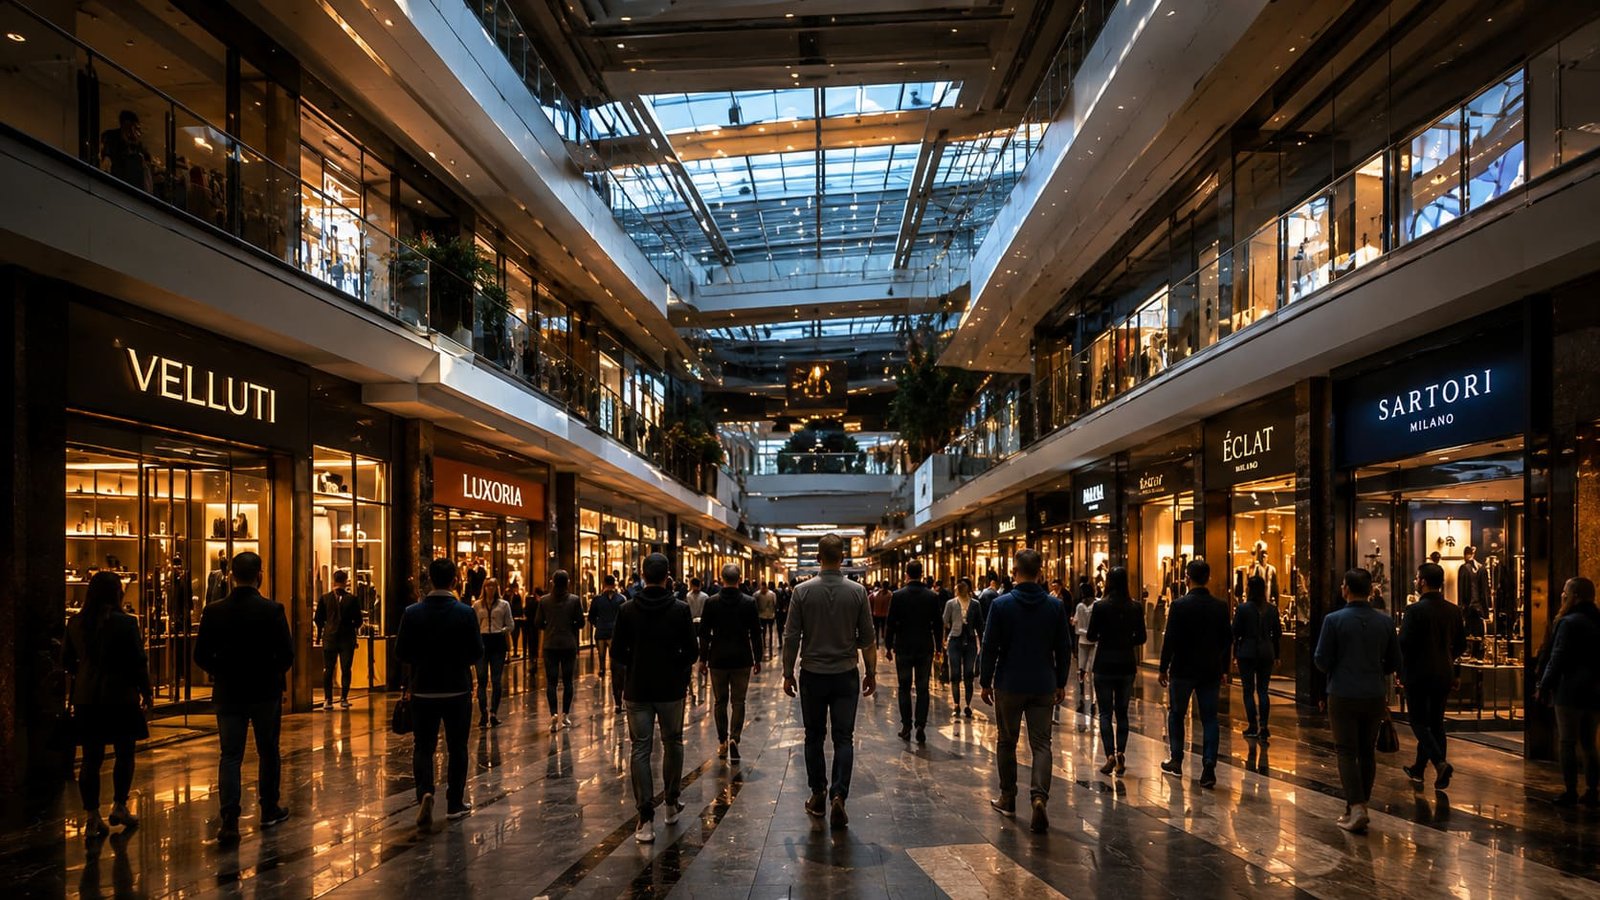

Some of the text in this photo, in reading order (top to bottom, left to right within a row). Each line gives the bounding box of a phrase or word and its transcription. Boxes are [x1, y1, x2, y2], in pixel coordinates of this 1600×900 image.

[126, 347, 275, 423] VELLUTI
[1378, 369, 1492, 421] SARTORI
[1410, 413, 1454, 432] MILANO
[1223, 426, 1274, 462] ÉCLAT
[463, 474, 523, 507] LUXORIA
